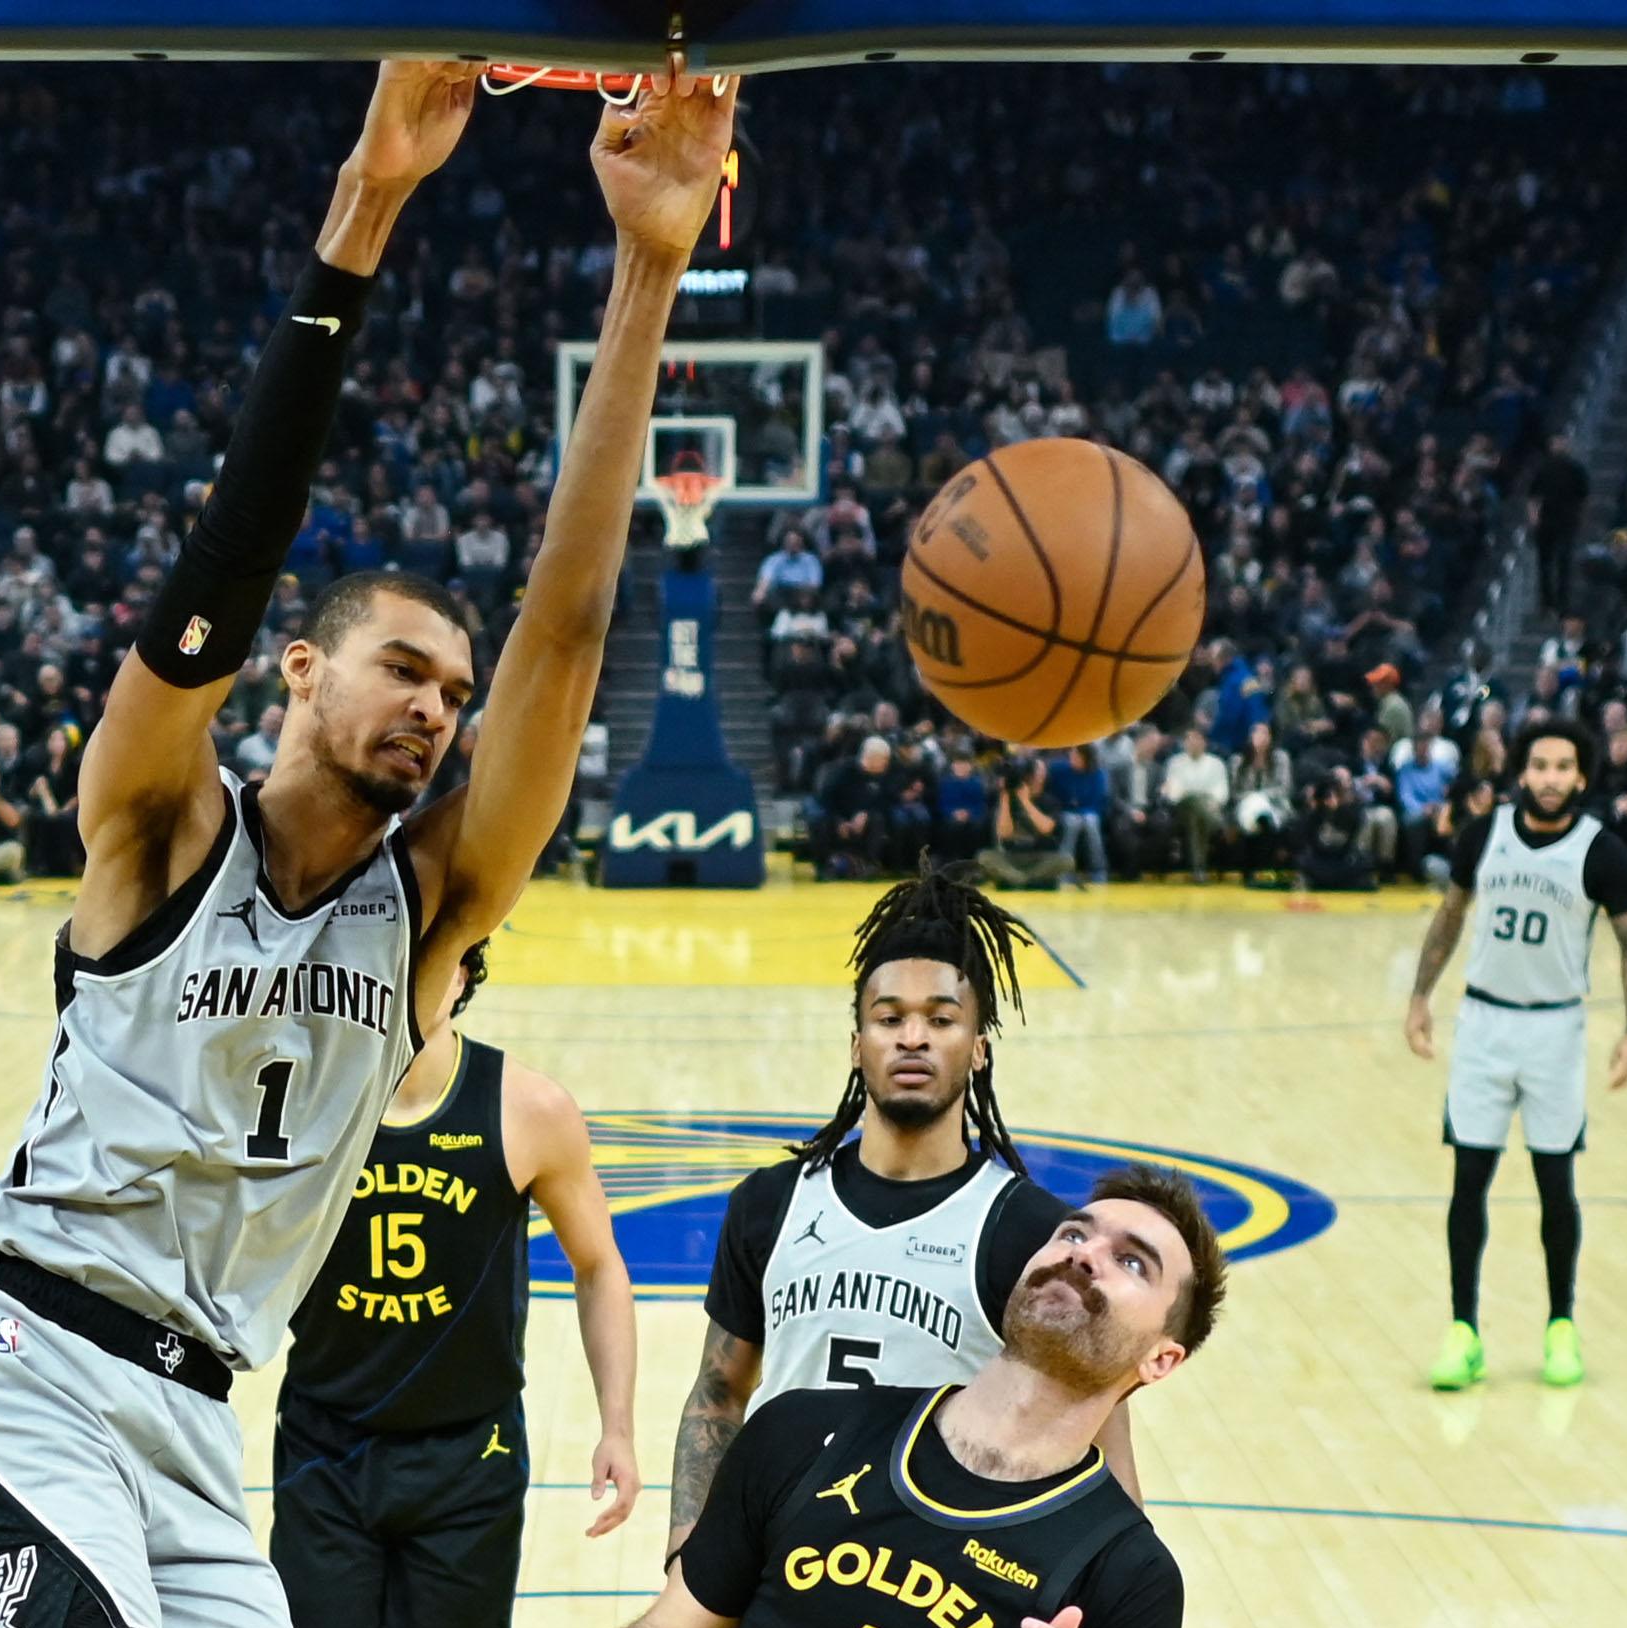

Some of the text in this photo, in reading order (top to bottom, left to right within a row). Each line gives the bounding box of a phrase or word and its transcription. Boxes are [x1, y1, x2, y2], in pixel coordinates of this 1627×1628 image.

[332, 903, 387, 917] LEDGER
[1493, 904, 1549, 946] 30
[177, 965, 261, 1025] SAN
[244, 1058, 298, 1162] 1
[429, 1133, 483, 1150] Rakuten
[352, 1163, 477, 1215] OLDEN
[370, 1212, 426, 1279] 15
[914, 1242, 956, 1258] LEDGER
[337, 1283, 453, 1324] STATE
[771, 1270, 964, 1353] SAN ANTONIO
[962, 1538, 1039, 1590] Rakuten
